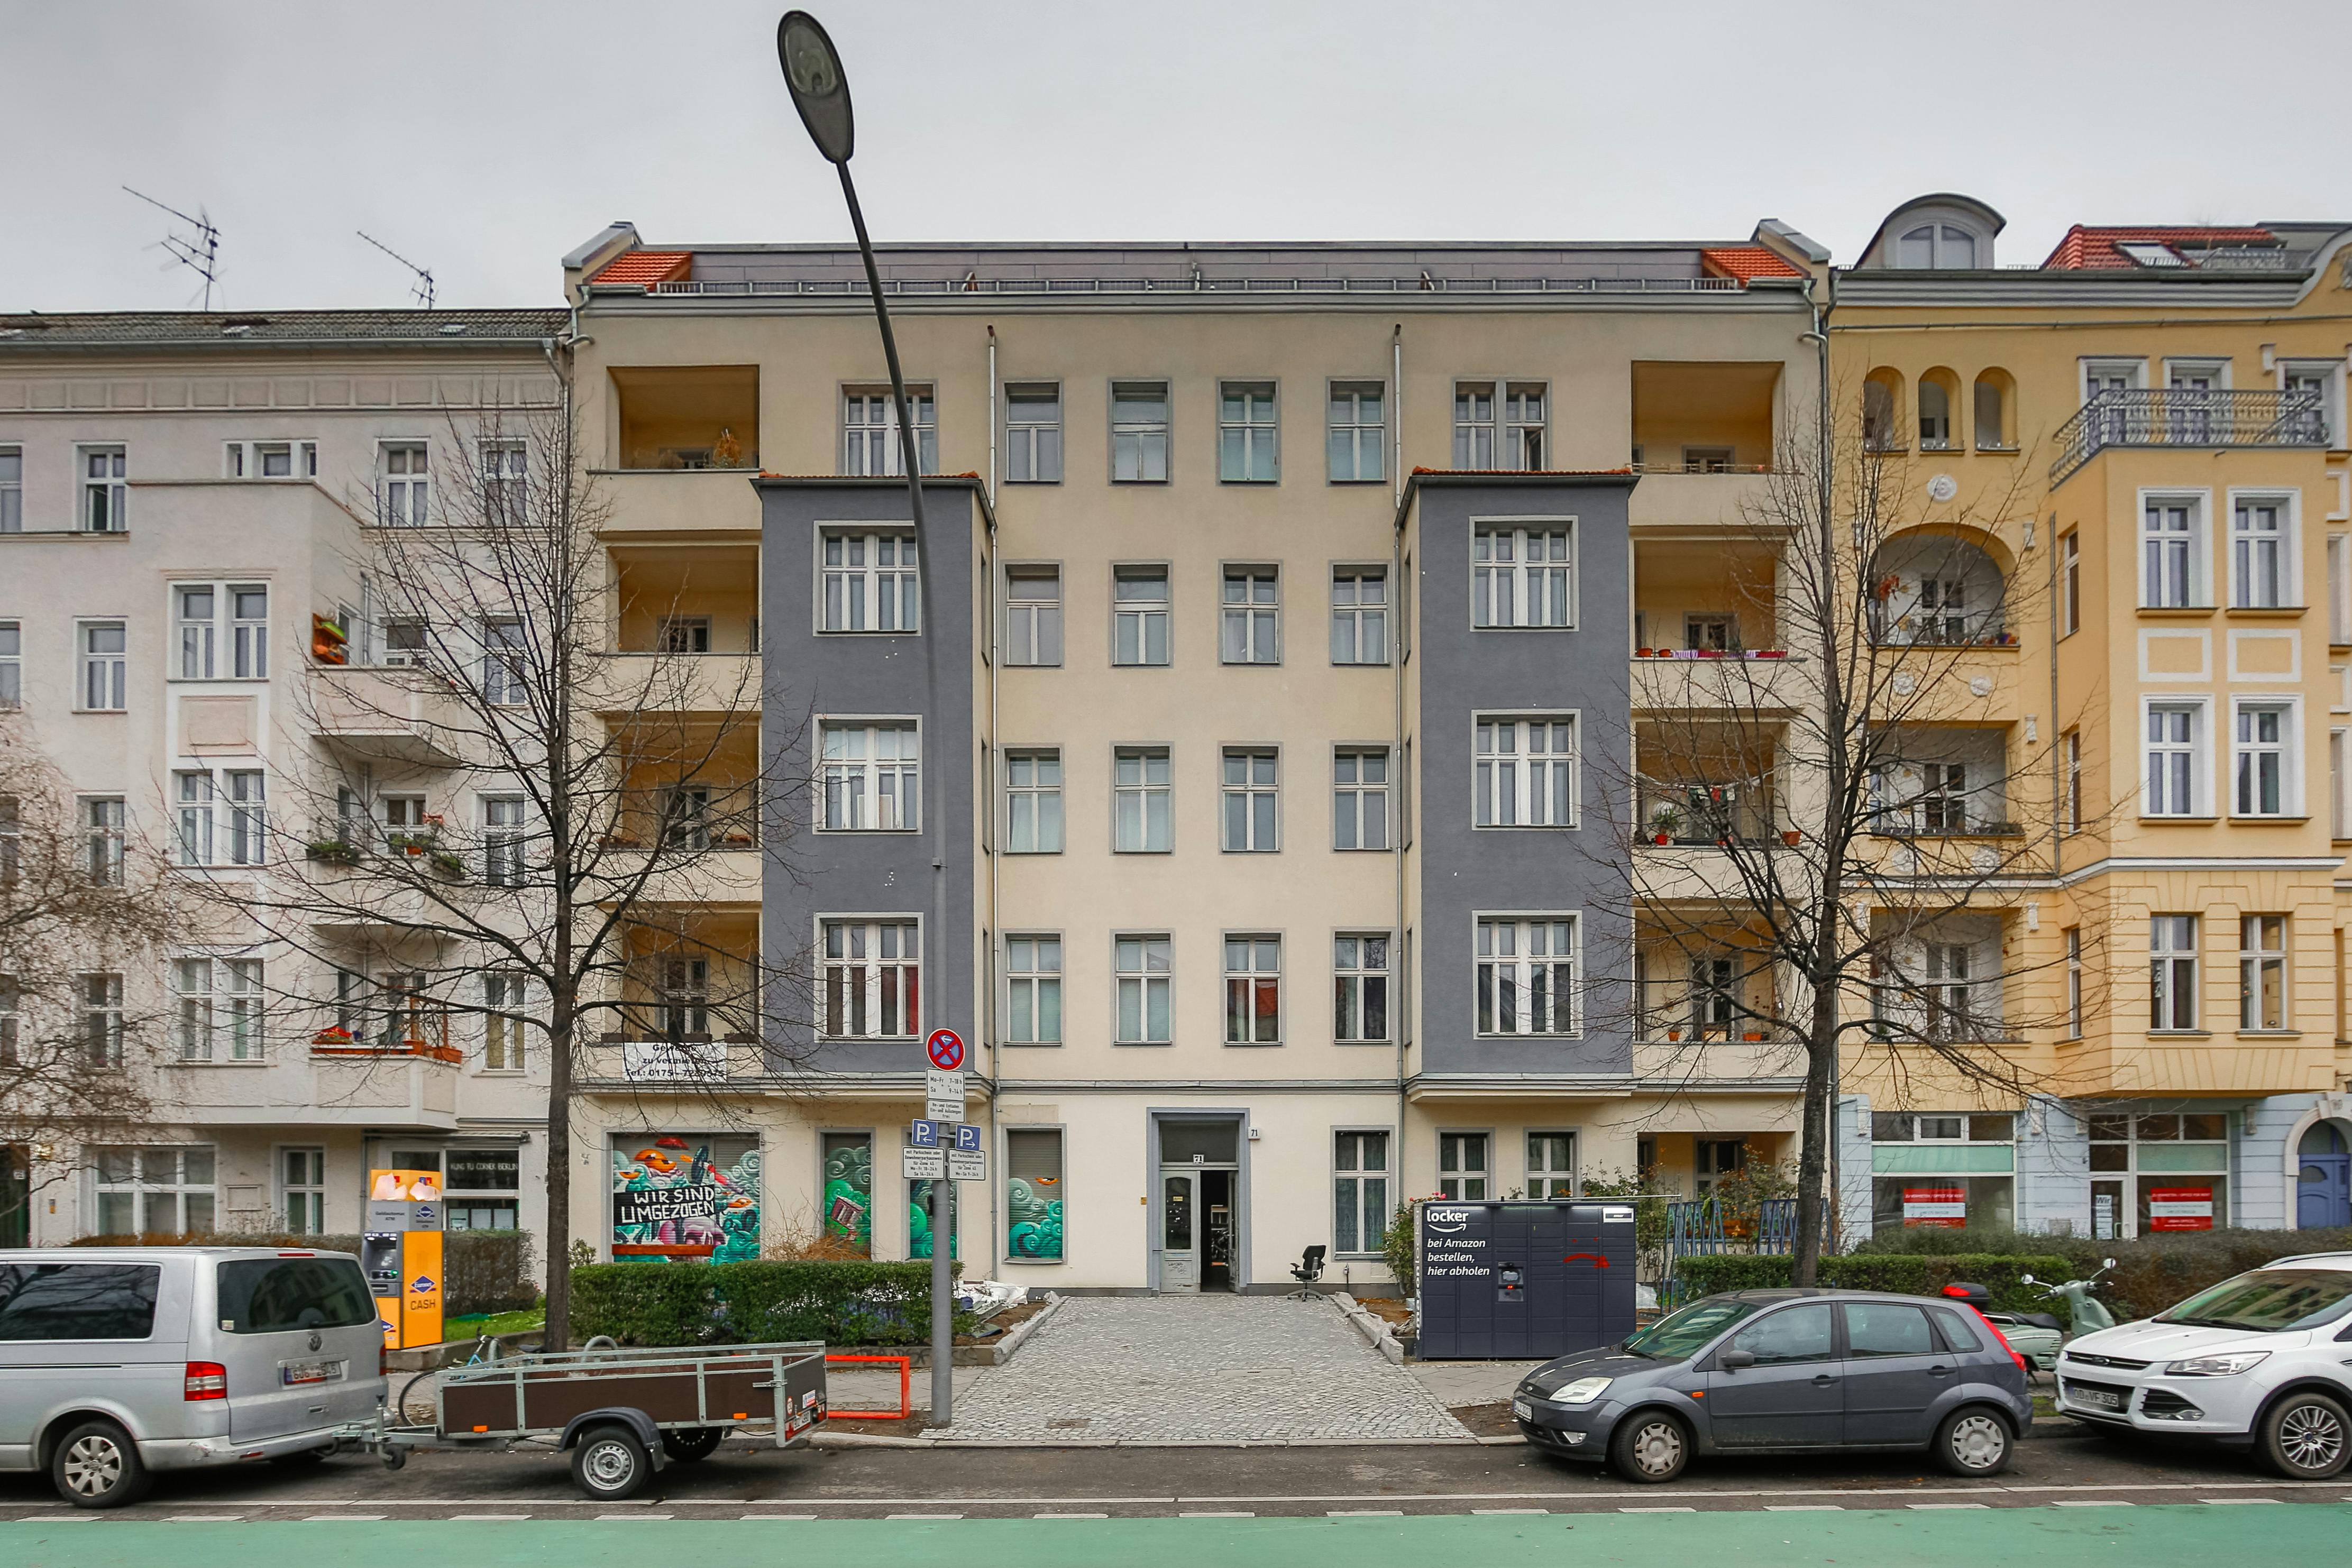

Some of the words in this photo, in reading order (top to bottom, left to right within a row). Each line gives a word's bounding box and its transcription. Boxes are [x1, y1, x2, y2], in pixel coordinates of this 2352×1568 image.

[917, 1123, 930, 1142] P
[960, 1128, 973, 1147] P
[634, 1190, 670, 1204] WIR
[673, 1187, 715, 1203] SIND
[621, 1201, 715, 1223] UMGEZOGEN
[1426, 1209, 1469, 1222] locker
[1427, 1238, 1443, 1248] bei
[1444, 1239, 1486, 1248] Amazon
[1427, 1252, 1475, 1263] bestellen,
[1427, 1266, 1448, 1276] hier
[1449, 1266, 1490, 1276] abholen
[410, 1299, 436, 1310] CASH
